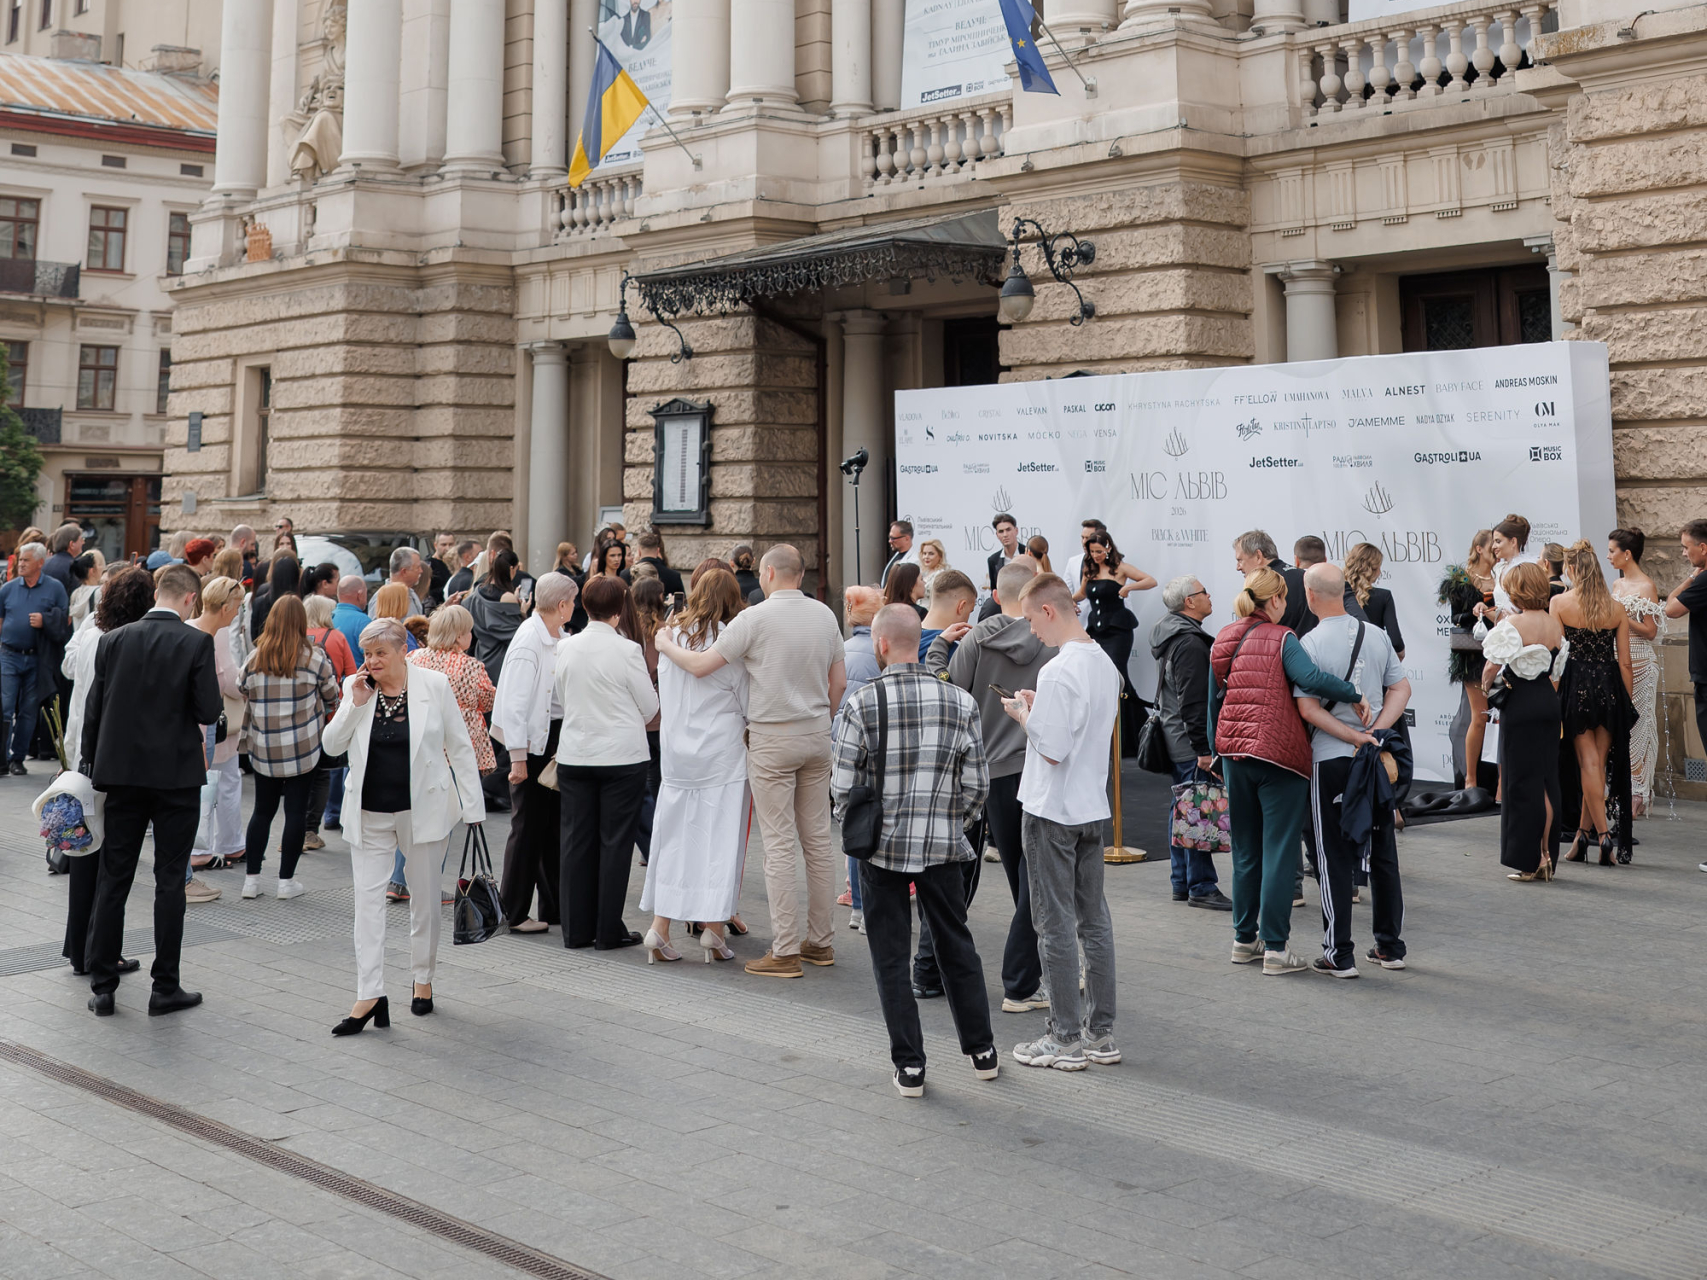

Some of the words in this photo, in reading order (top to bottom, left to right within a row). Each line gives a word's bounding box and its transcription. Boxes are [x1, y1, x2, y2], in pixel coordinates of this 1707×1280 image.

[951, 24, 1006, 43] МІРОШНИЧЕНК
[972, 35, 1007, 48] ЗАВІЙСЬК
[1435, 383, 1458, 394] BABY
[1461, 381, 1484, 392] FACE
[1494, 378, 1527, 389] ANDREAS
[1529, 375, 1558, 386] MOSKIN
[1385, 385, 1426, 397] ALNEST
[1064, 405, 1086, 414] PASKAL
[1466, 410, 1520, 422] SERENITY
[978, 433, 1018, 441] NOVITSKA
[1093, 429, 1117, 438] VENSA
[1414, 452, 1458, 464] GASTROLI
[1468, 452, 1482, 461] UA
[1544, 452, 1562, 461] BOX
[1094, 465, 1106, 473] BOX
[1131, 472, 1168, 499] МІС
[964, 525, 994, 552] МІС
[1380, 570, 1392, 580] 26
